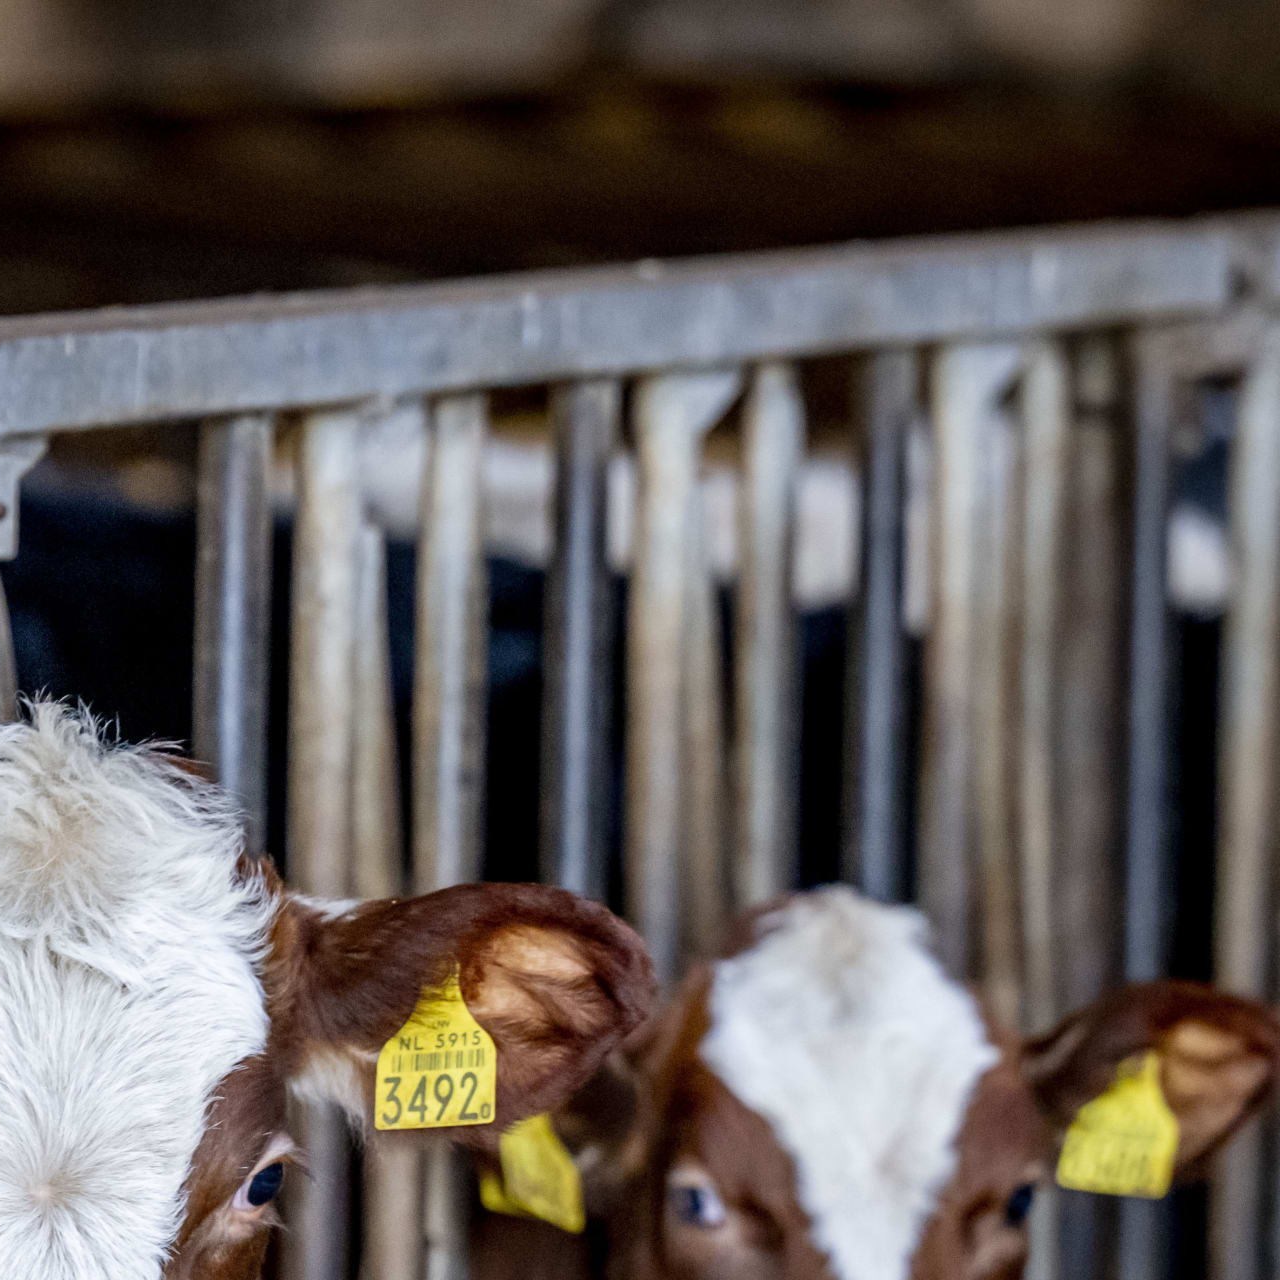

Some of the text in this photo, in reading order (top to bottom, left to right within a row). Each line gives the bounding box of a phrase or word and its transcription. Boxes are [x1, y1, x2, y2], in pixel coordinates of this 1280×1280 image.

[399, 1030, 481, 1050] NL 5915
[383, 1072, 478, 1125] 3492
